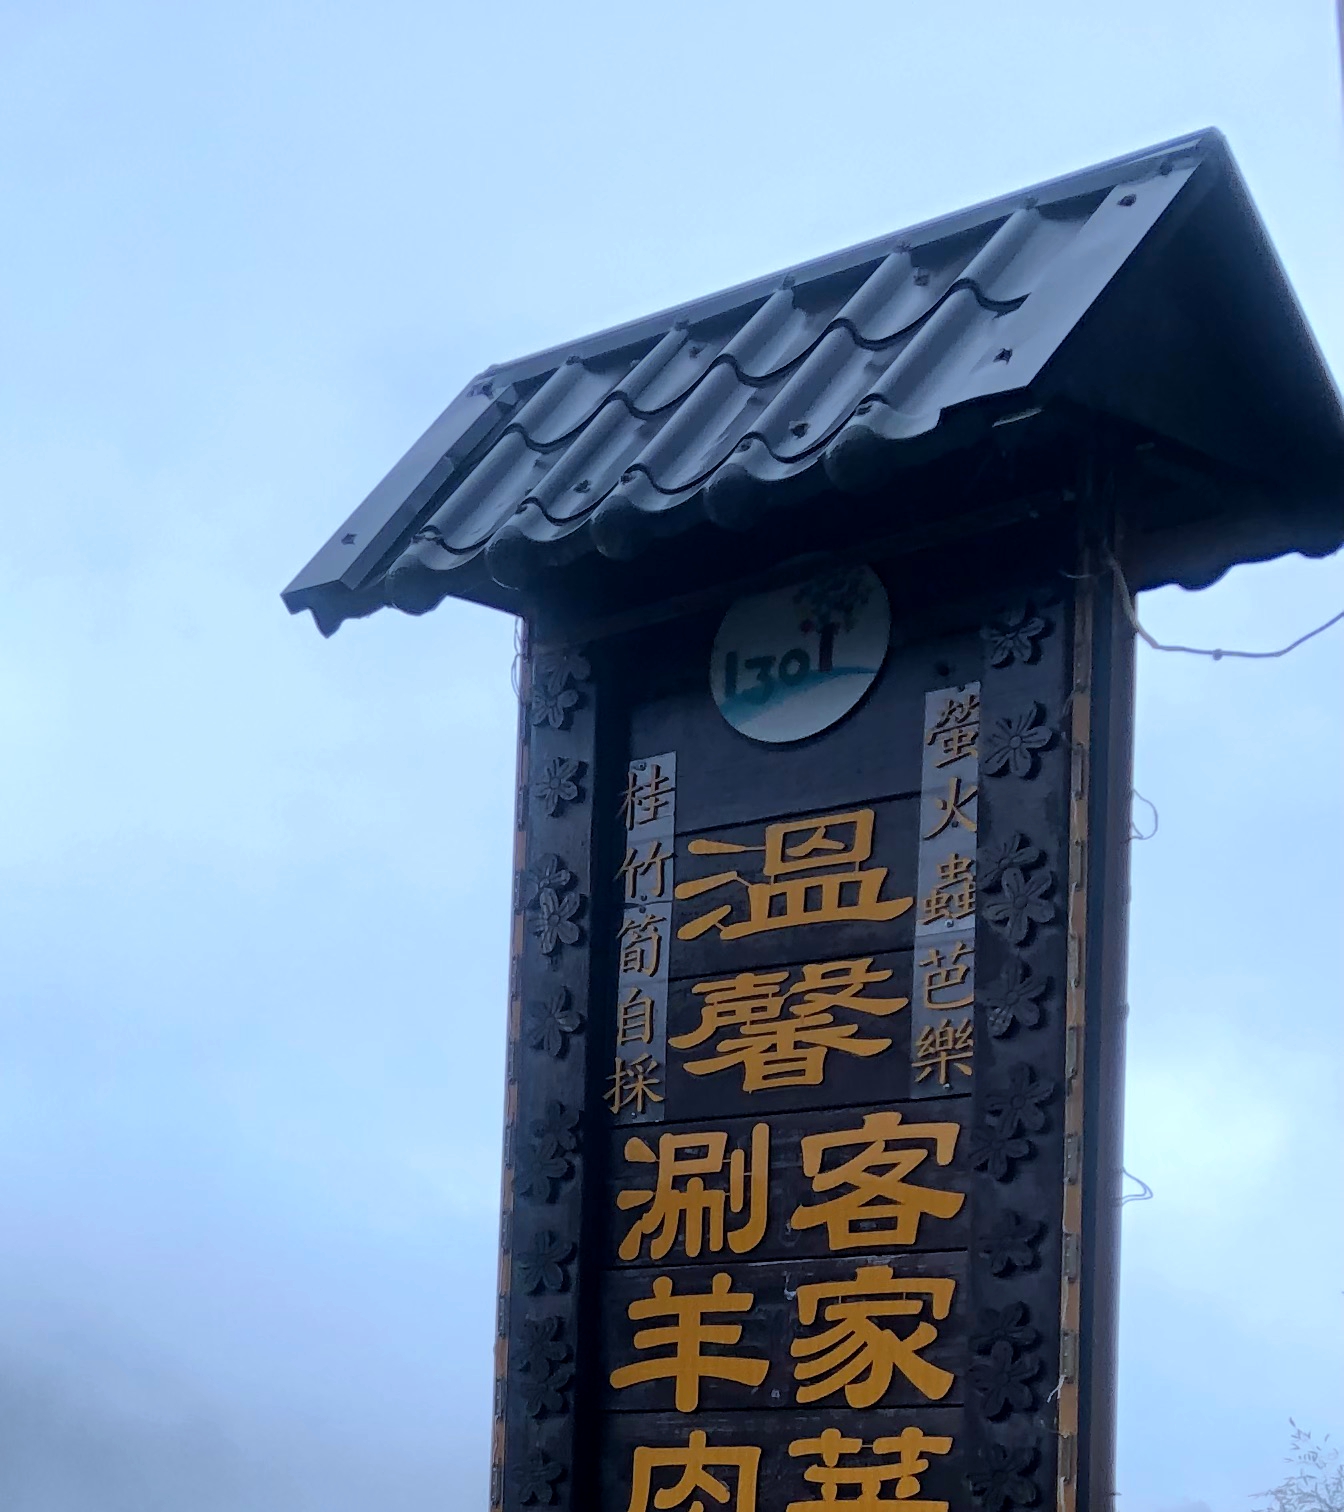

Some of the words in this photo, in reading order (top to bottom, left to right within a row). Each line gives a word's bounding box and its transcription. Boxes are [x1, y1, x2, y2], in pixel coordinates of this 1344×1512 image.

[602, 763, 675, 1115] 桂竹筍自採
[668, 807, 915, 1094] 溫馨
[913, 692, 980, 1086] 螢火蟲芭樂
